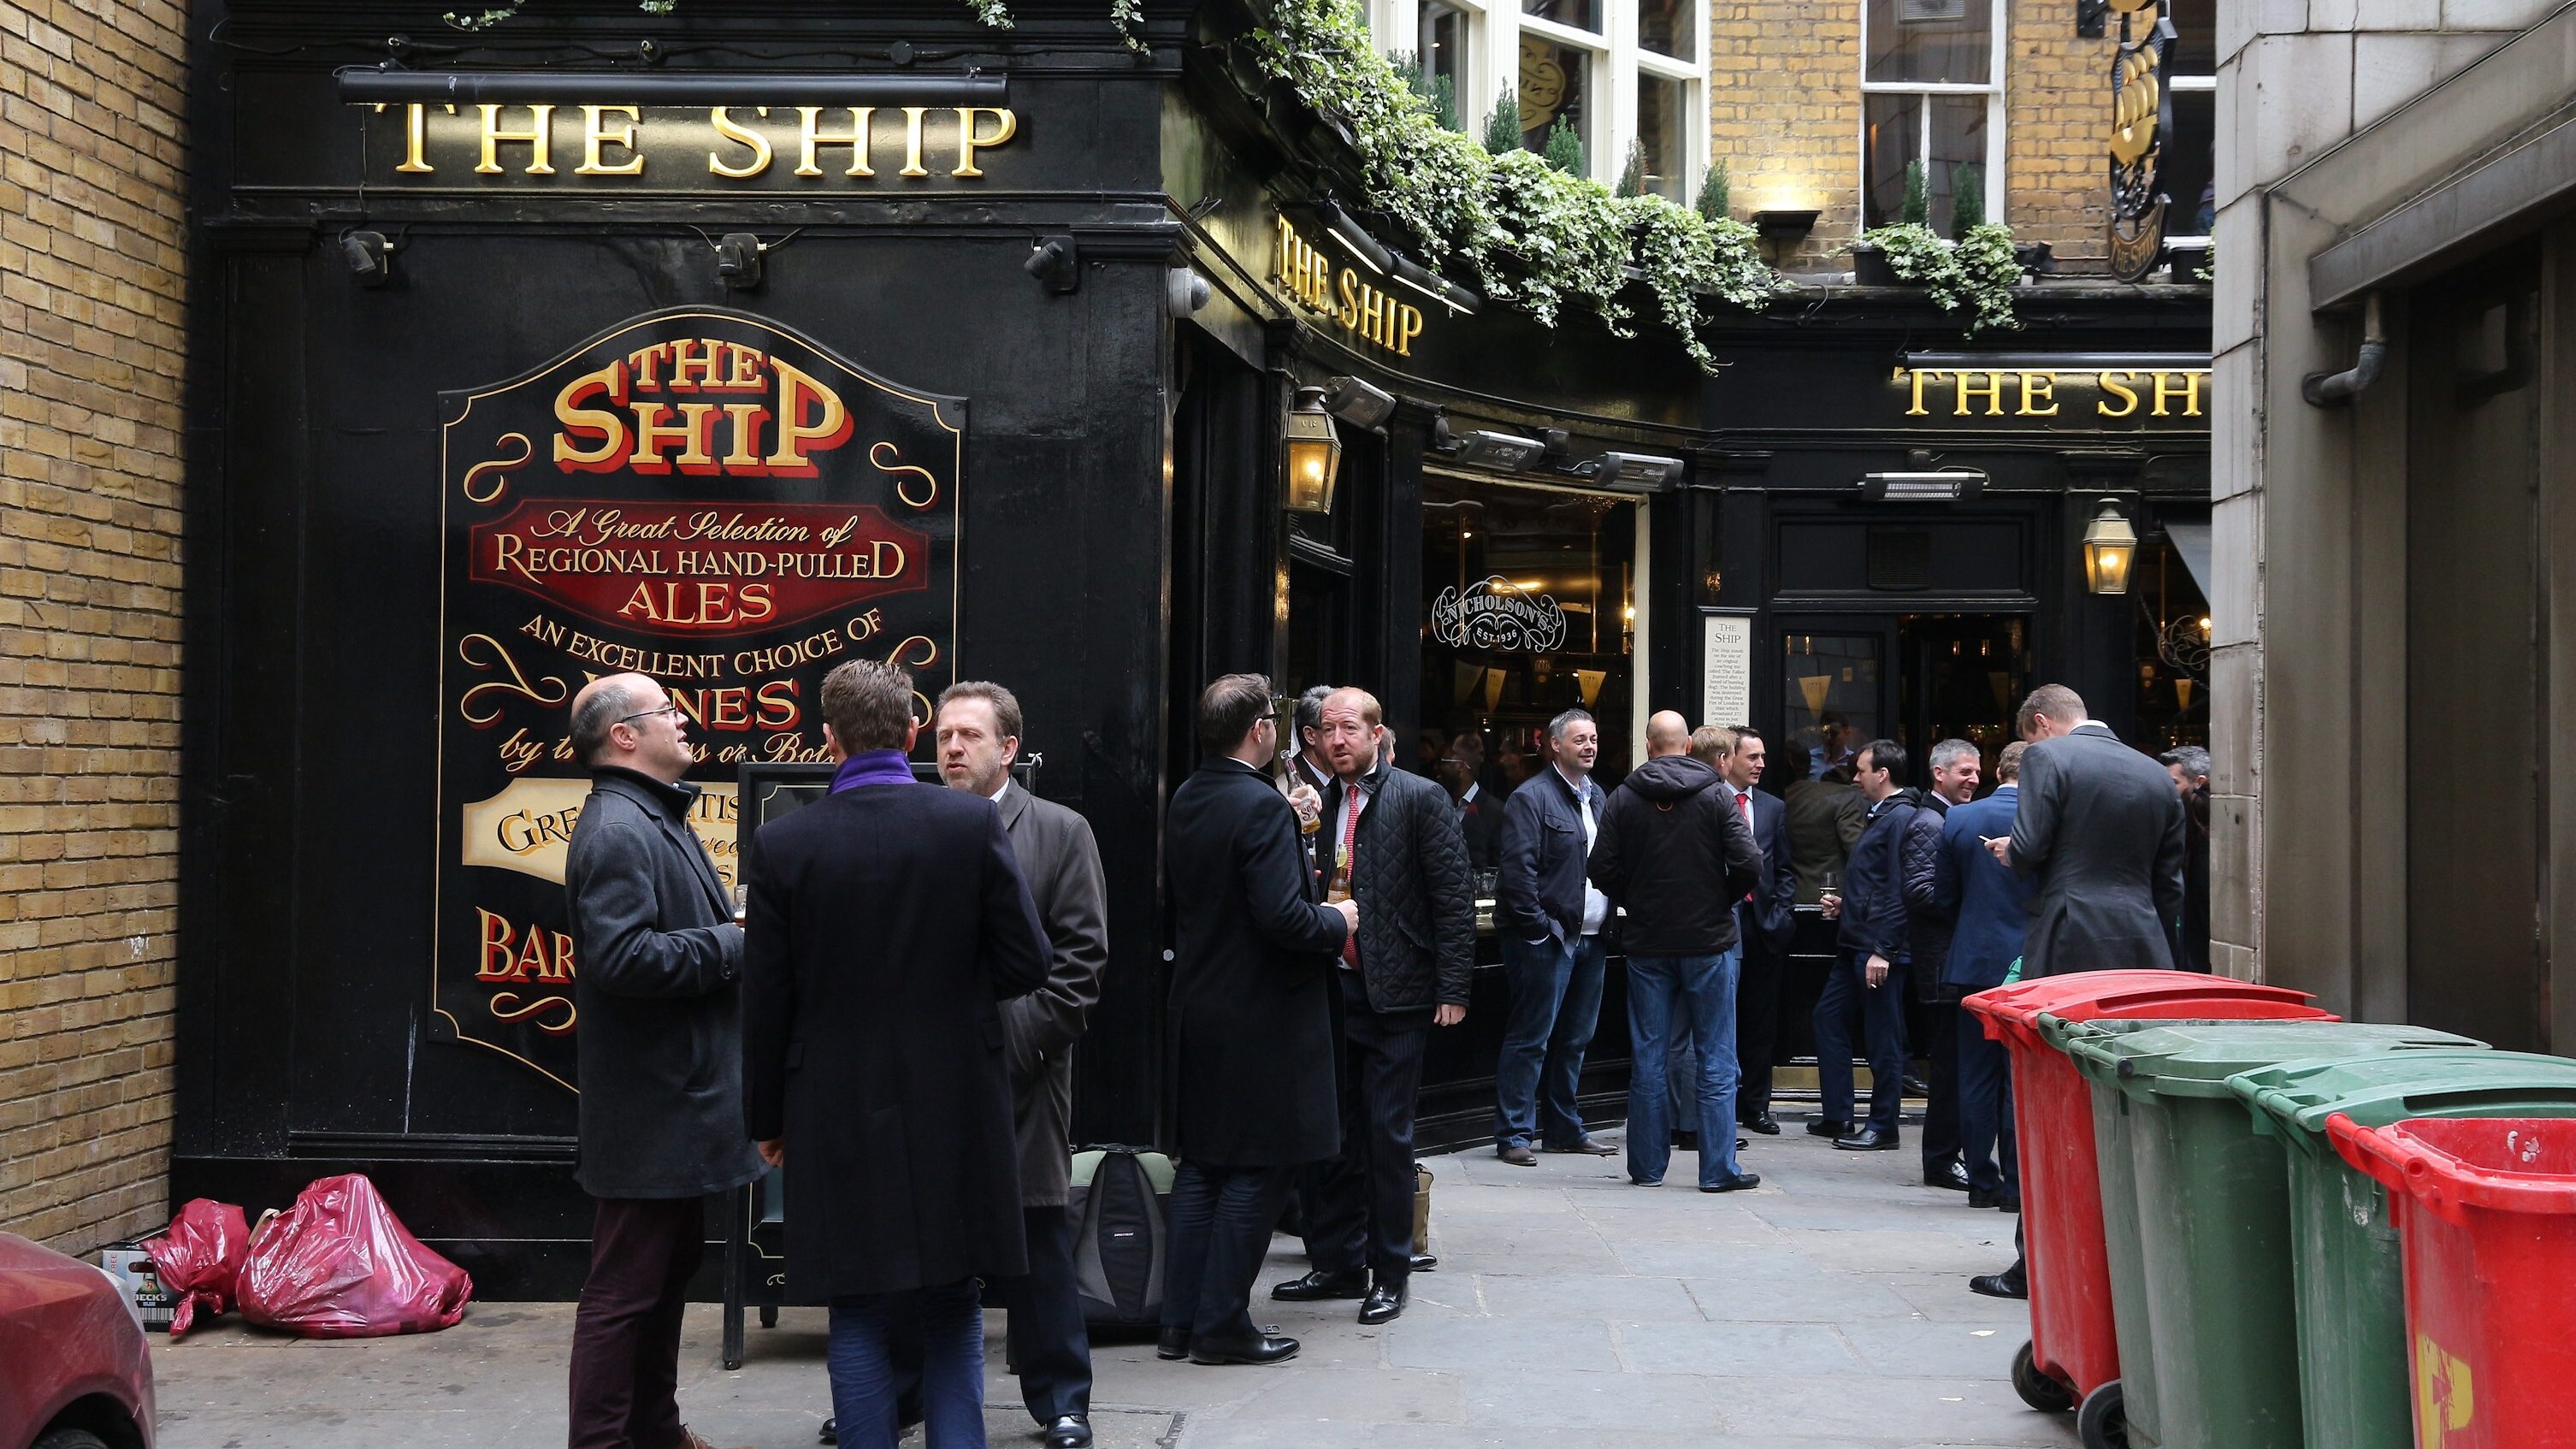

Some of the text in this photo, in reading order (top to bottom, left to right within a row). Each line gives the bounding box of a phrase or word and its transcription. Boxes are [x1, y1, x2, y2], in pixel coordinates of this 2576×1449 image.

[375, 103, 1017, 179] THE SHIP
[1277, 213, 1423, 358] THE SHIP
[627, 338, 766, 393] THE
[552, 354, 853, 477] SHIP
[1891, 365, 2203, 417] THE SH
[530, 507, 859, 550] A Great Selection of
[493, 533, 906, 584] REGIONAL HAND-PULLED
[617, 581, 776, 629] ALES
[1446, 594, 1550, 631] NICHOLSON'S
[1718, 623, 1737, 632] THE
[519, 607, 885, 678] AN EXCELLENT CHOICE OF
[1714, 633, 1741, 644] SHIP
[499, 727, 545, 772] by
[717, 742, 747, 763] or
[497, 806, 579, 852] GRE
